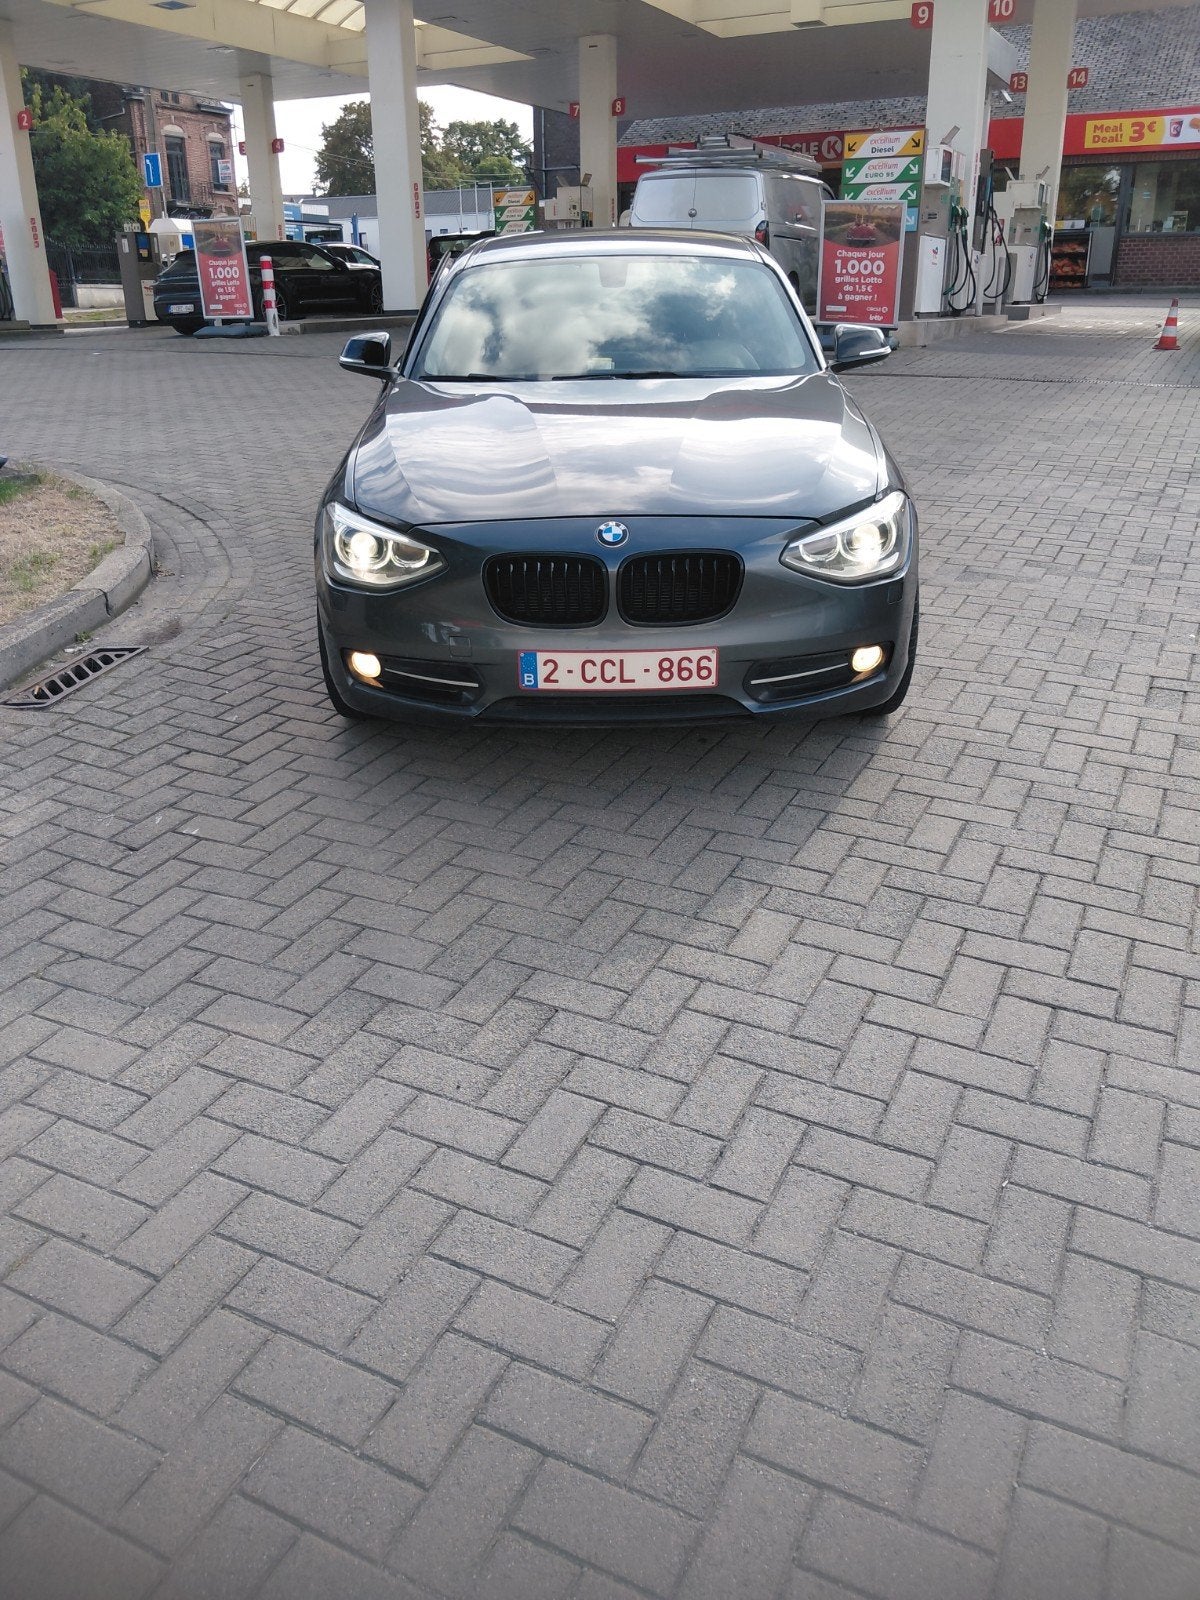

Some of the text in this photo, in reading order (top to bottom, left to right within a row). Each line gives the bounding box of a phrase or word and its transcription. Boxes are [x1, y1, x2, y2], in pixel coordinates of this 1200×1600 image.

[917, 6, 929, 24] 9
[992, 0, 1013, 17] 10
[1012, 76, 1026, 89] 13
[1071, 71, 1087, 85] 14
[573, 105, 580, 117] 7
[615, 100, 622, 113] 8
[21, 113, 29, 126] 2
[1093, 123, 1123, 133] Meal
[1092, 134, 1124, 144] Deal!
[871, 146, 894, 154] Diesel
[836, 250, 885, 259] Chaque jour
[208, 266, 240, 279] 1.000
[834, 259, 885, 275] 1.000
[835, 275, 883, 284] grilles Lotto
[843, 284, 854, 292] de
[838, 292, 843, 300] à
[524, 673, 535, 686] B
